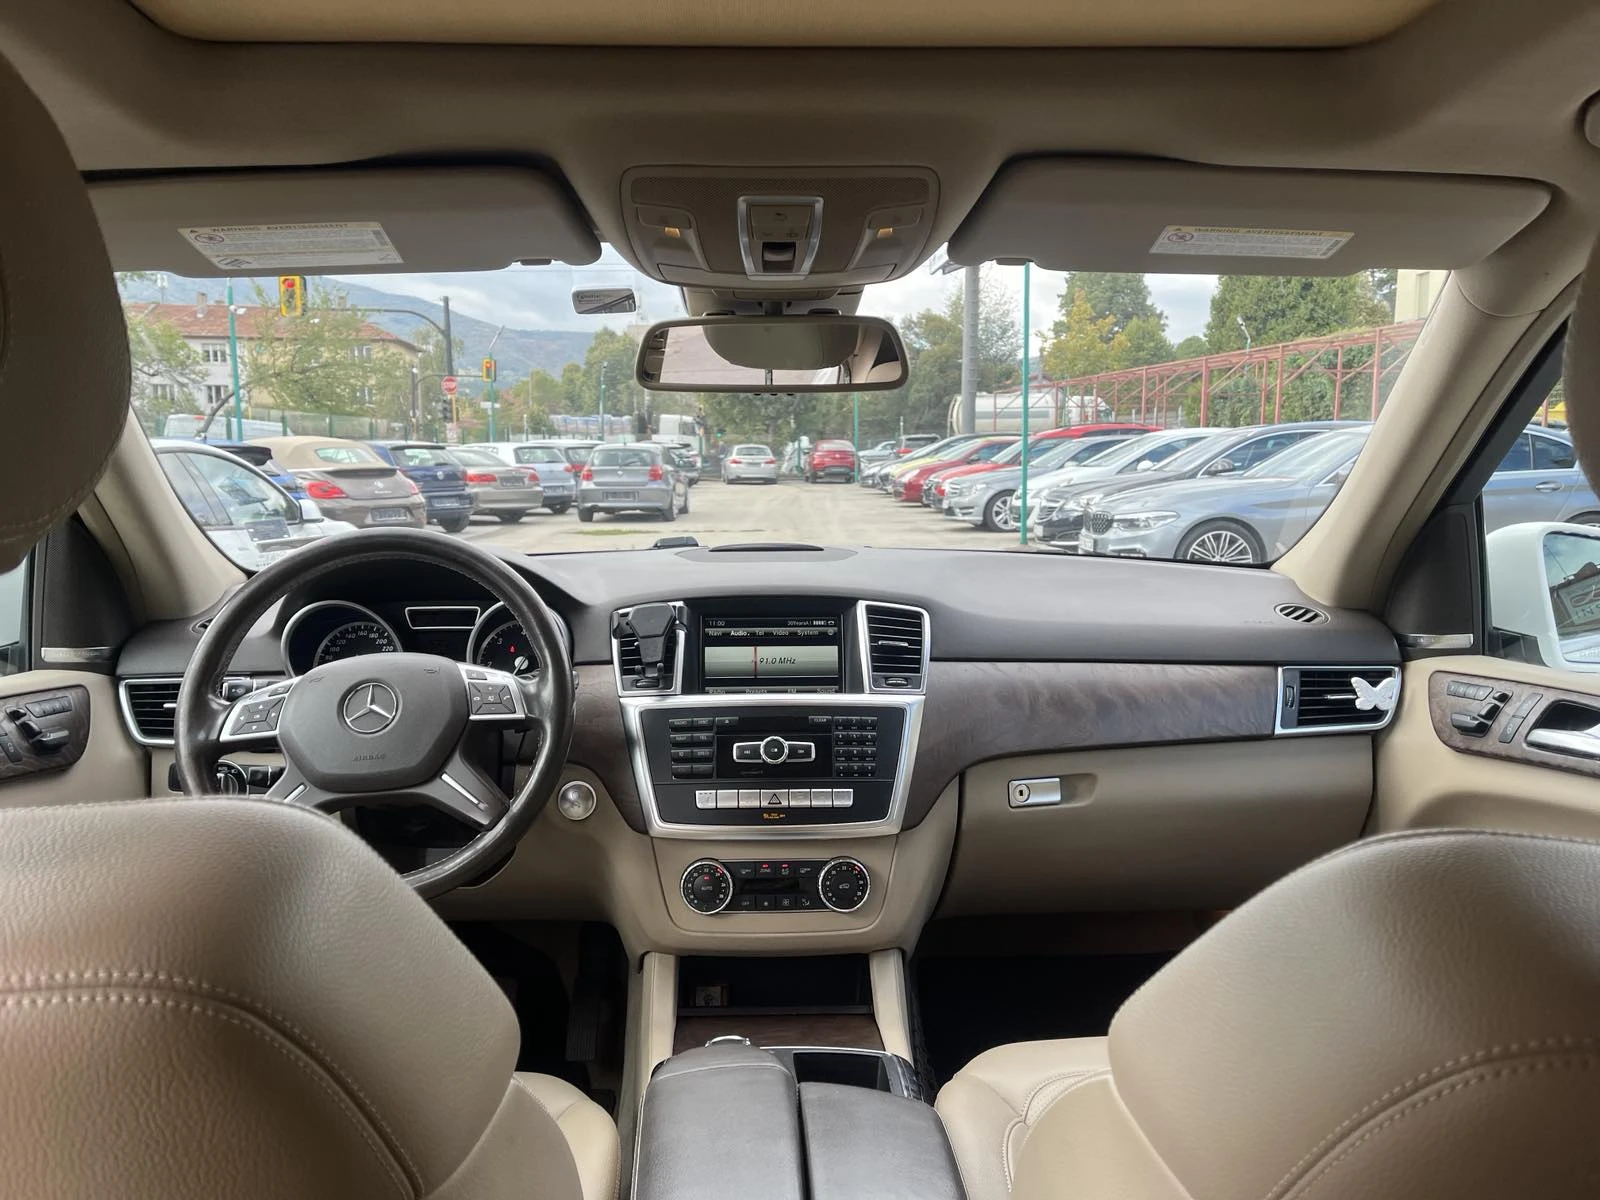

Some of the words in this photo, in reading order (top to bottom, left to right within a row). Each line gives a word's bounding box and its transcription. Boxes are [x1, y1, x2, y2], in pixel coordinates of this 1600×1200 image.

[797, 629, 818, 637] System
[759, 657, 776, 665] 91.0
[778, 657, 796, 665] MHz
